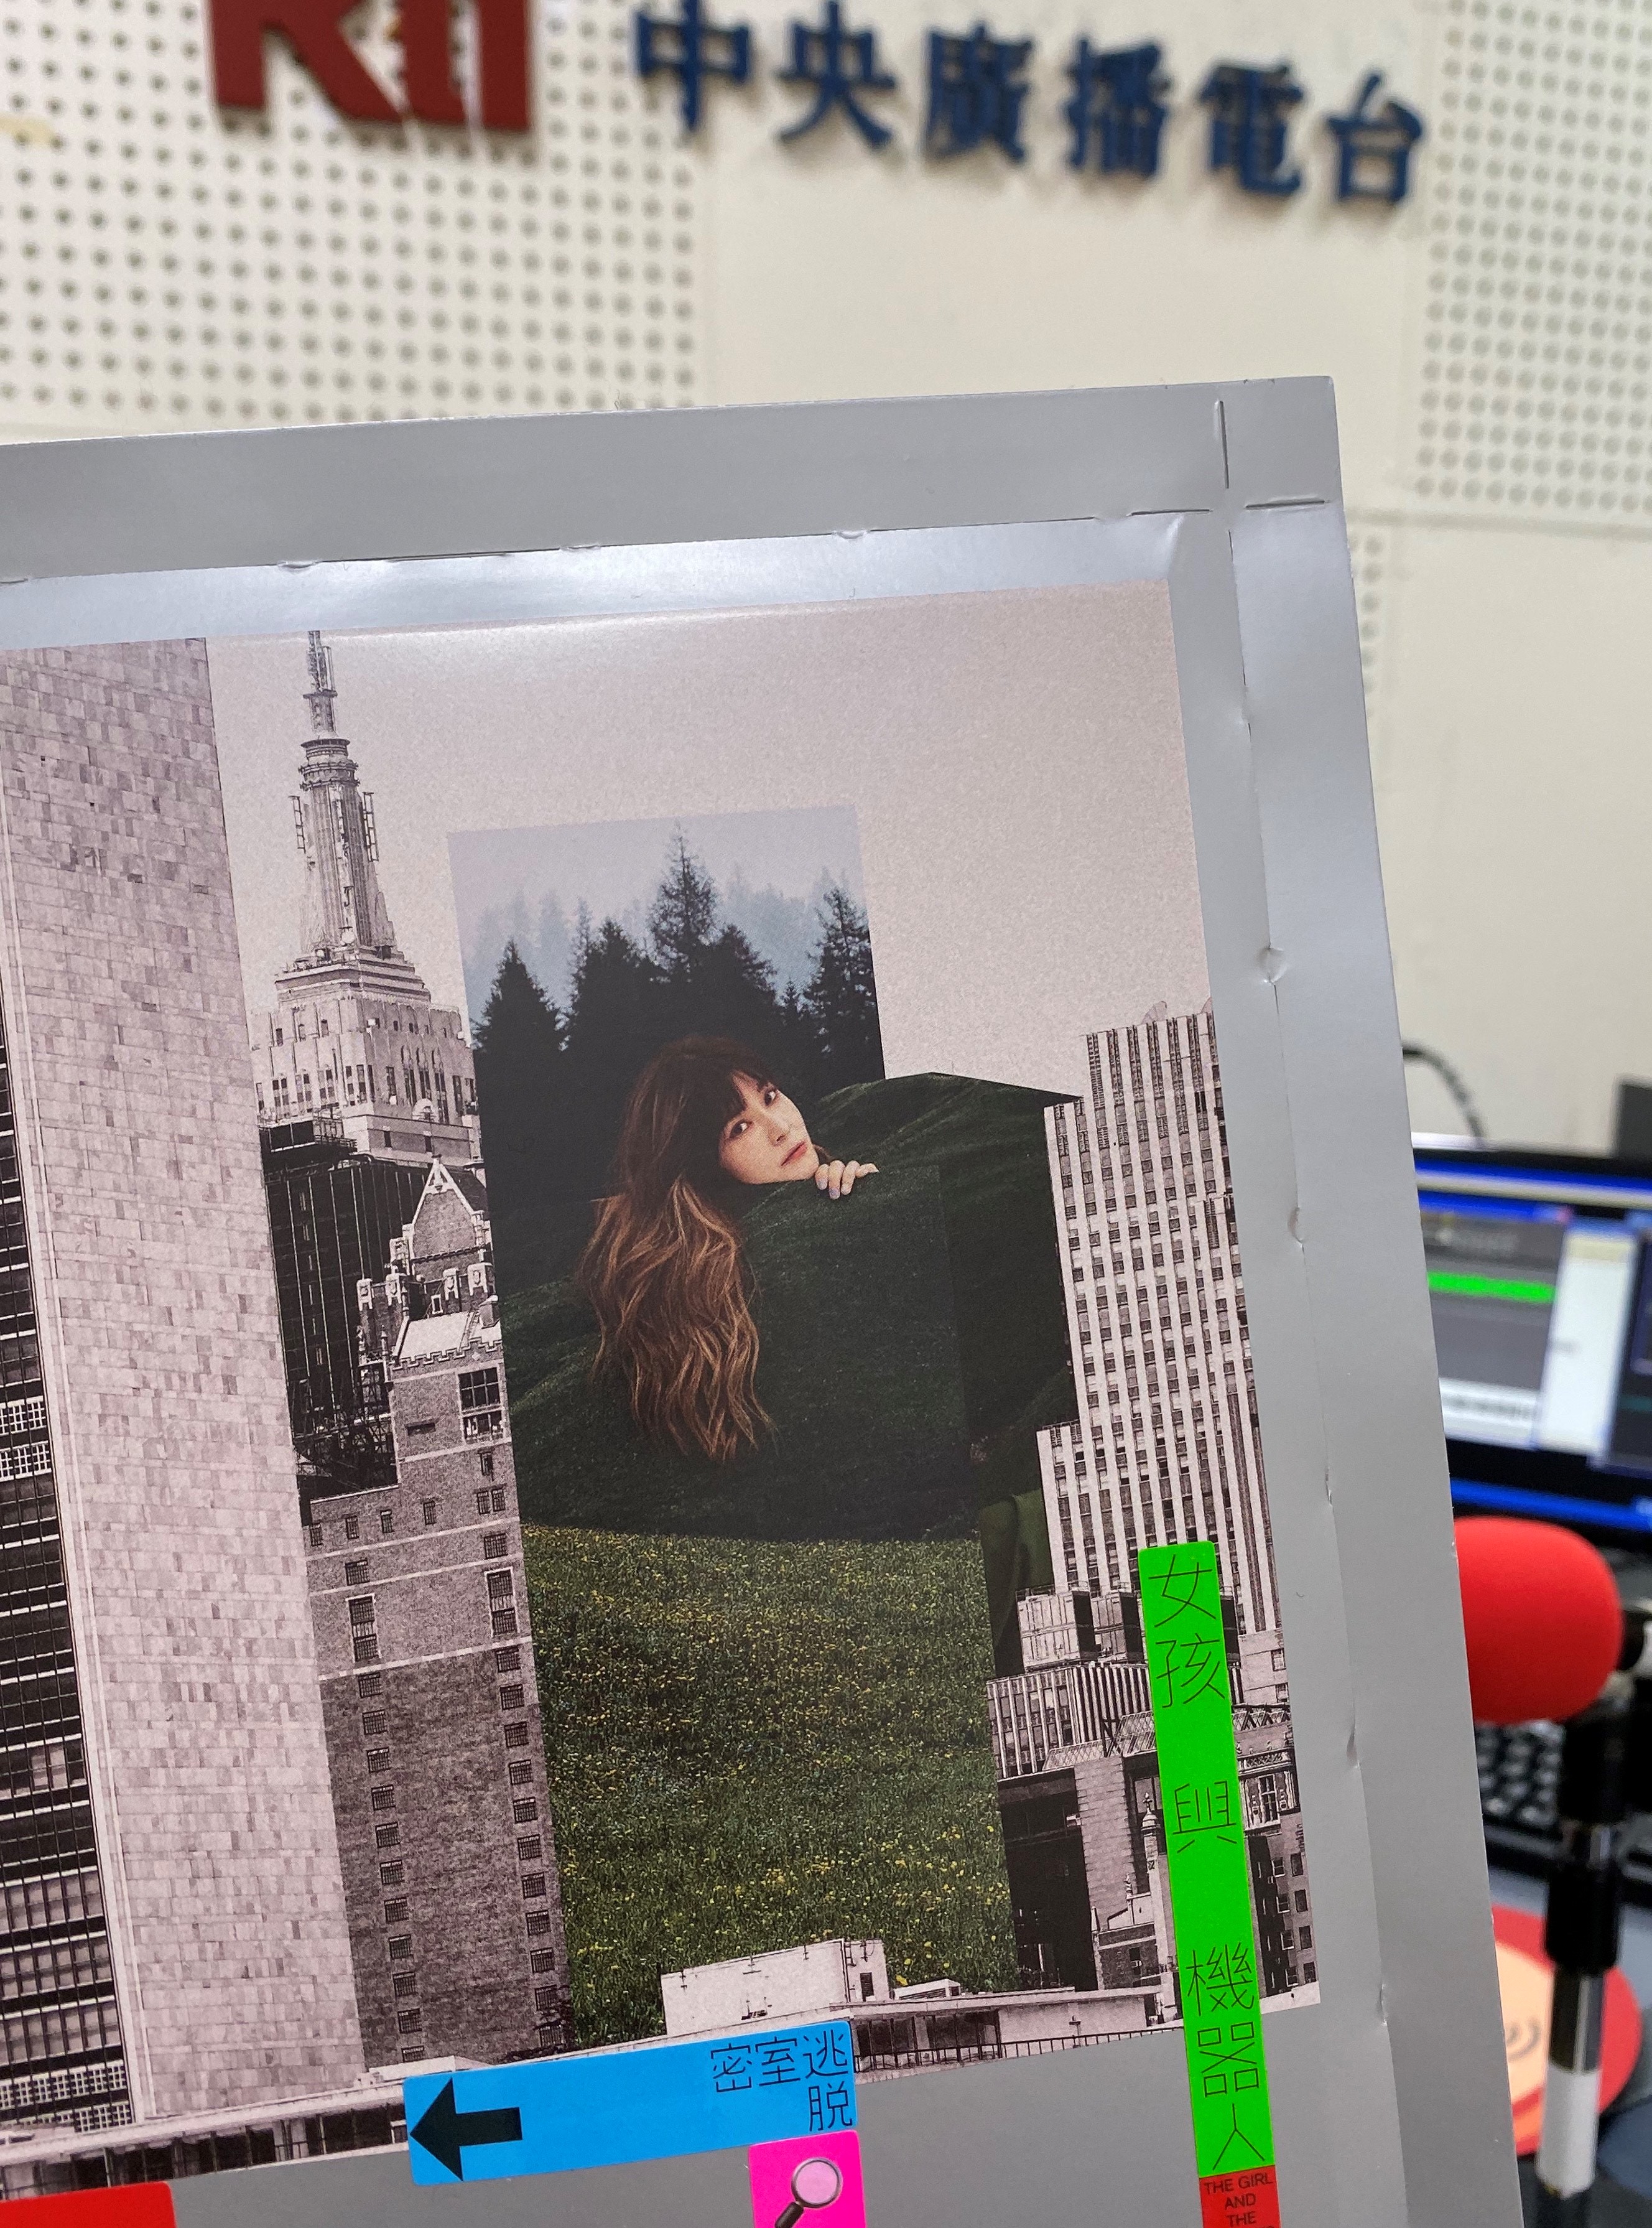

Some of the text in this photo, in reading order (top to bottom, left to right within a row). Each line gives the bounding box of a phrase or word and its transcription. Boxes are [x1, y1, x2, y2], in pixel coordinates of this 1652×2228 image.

[1148, 1554, 1226, 1708] 女孩
[710, 2029, 849, 2093] 密室逃
[1185, 1941, 1266, 2171] 機器人
[1204, 2172, 1274, 2195] THE GIRL
[1224, 2193, 1256, 2210] AND
[1225, 2211, 1257, 2227] THE
